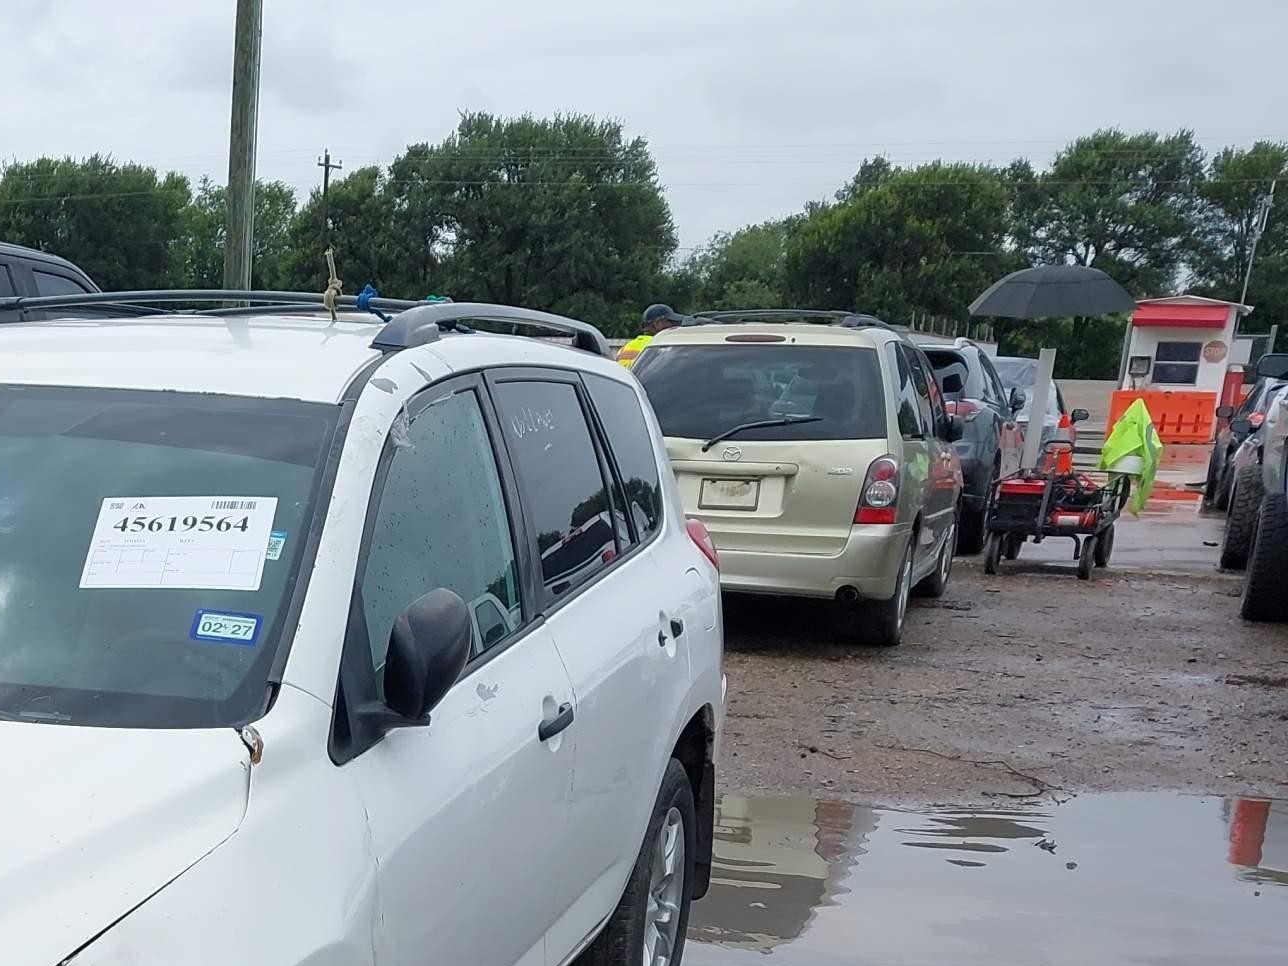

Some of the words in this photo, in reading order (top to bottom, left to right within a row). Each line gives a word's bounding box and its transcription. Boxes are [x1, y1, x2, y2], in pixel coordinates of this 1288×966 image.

[113, 515, 249, 533] 45619564
[201, 621, 223, 633] 02
[230, 624, 253, 636] 27
